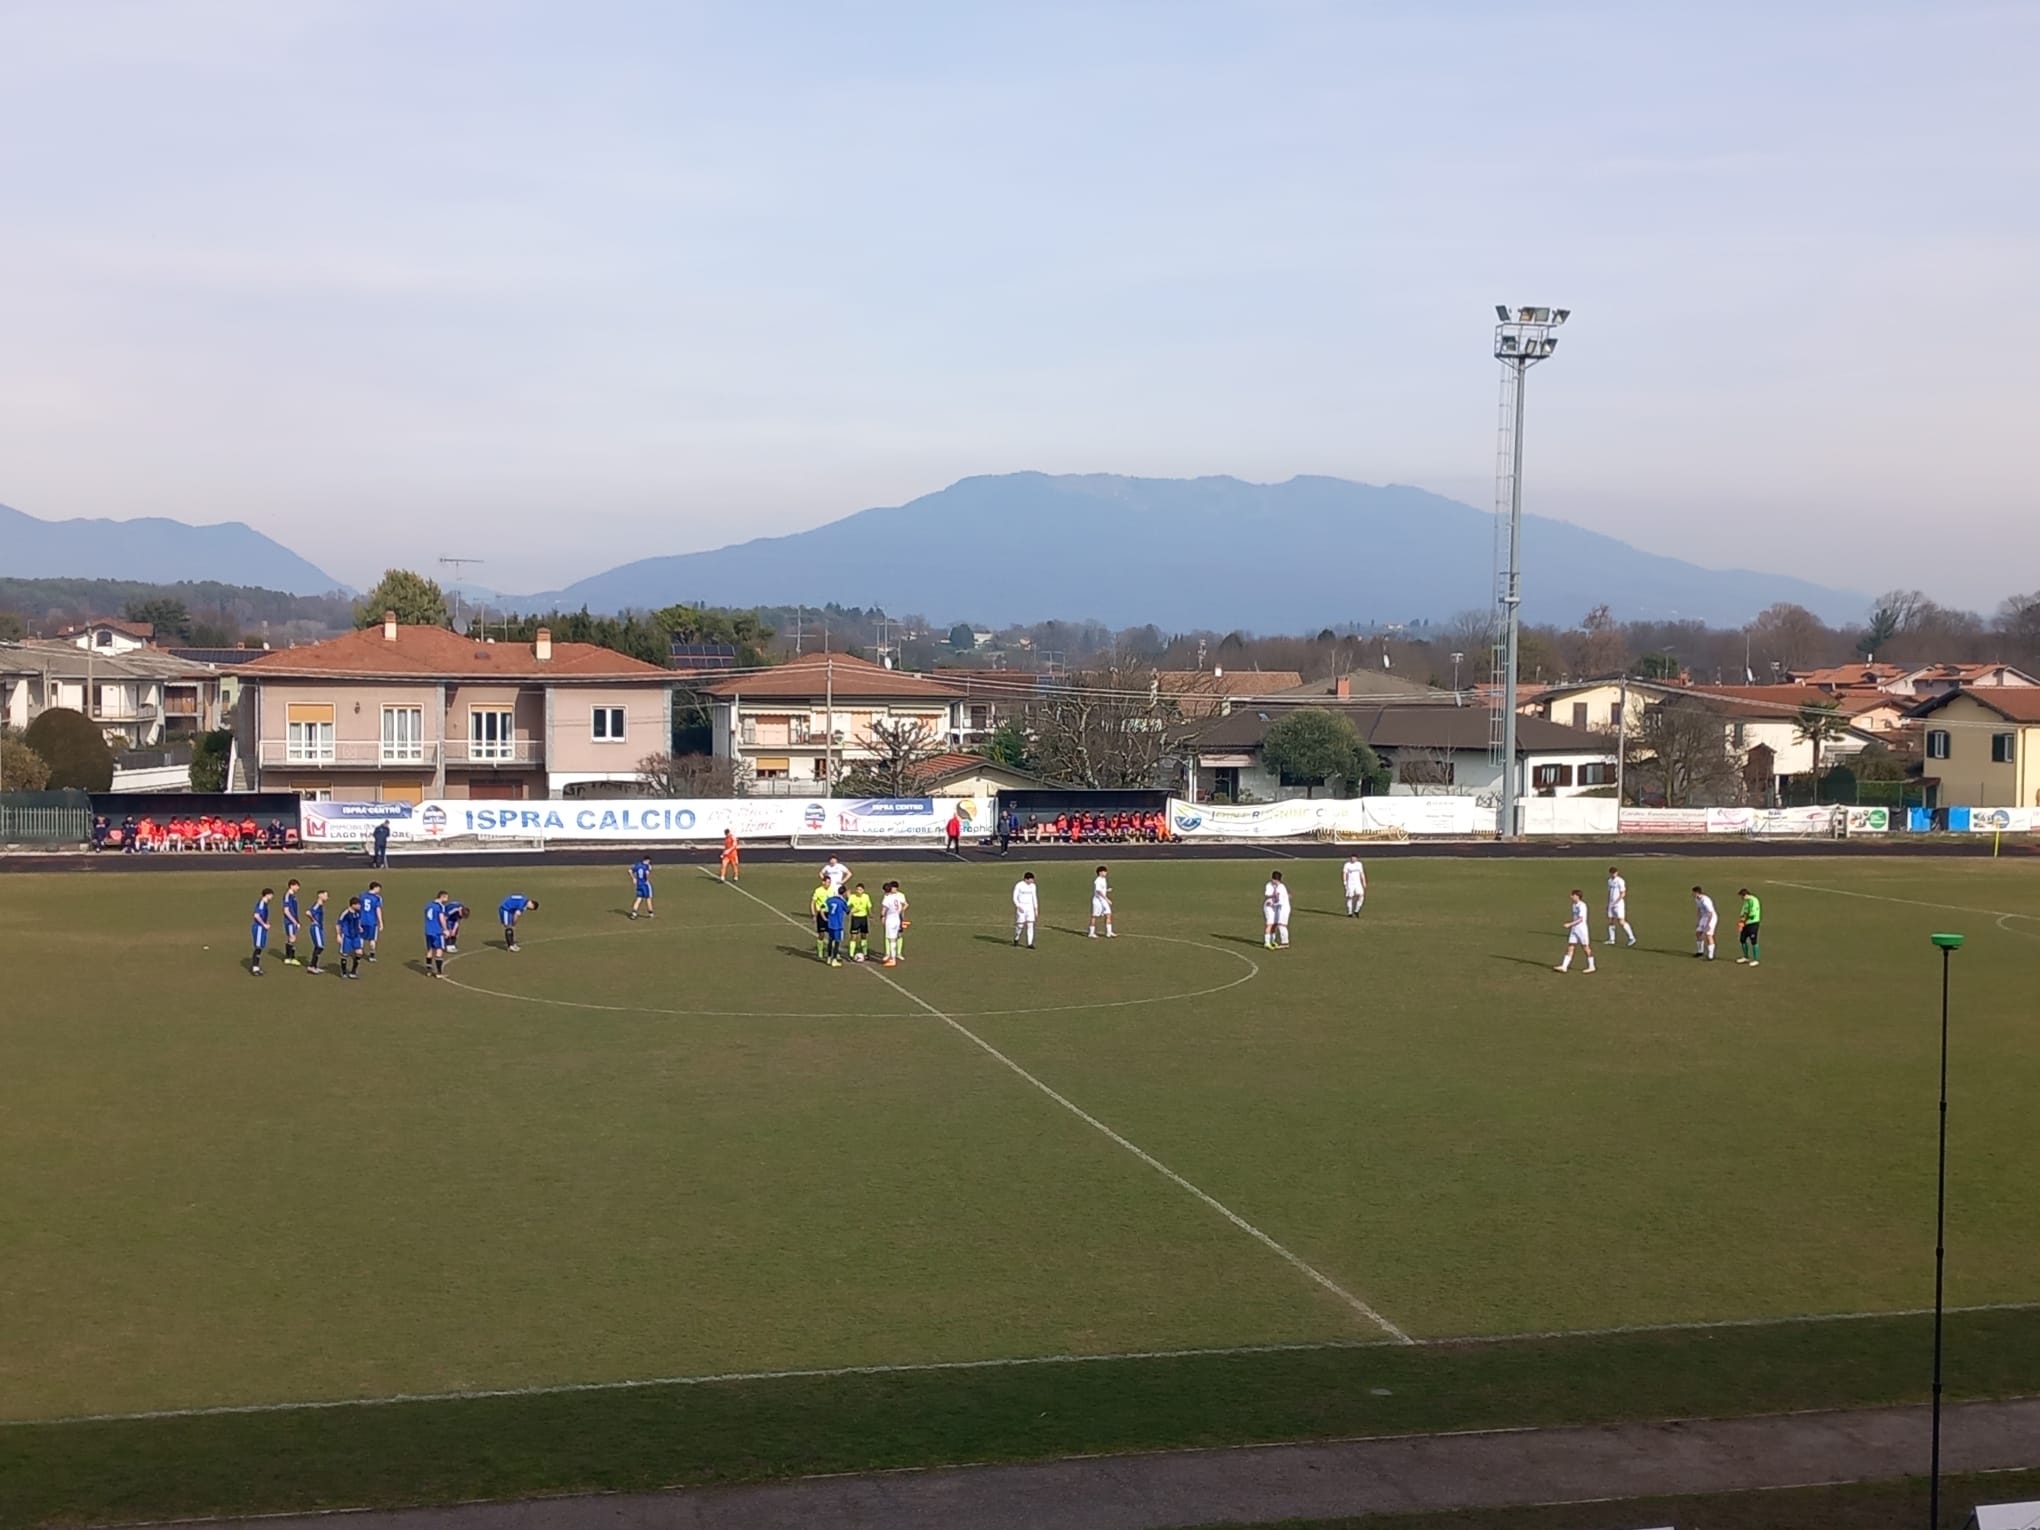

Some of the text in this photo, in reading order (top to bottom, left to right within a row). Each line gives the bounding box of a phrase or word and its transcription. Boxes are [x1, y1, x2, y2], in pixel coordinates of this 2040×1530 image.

[342, 804, 401, 815] ISPRA CENTRO
[465, 810, 564, 829] ISPRA
[576, 809, 696, 830] CALCIO
[364, 898, 372, 912] 5
[831, 903, 838, 915] 7
